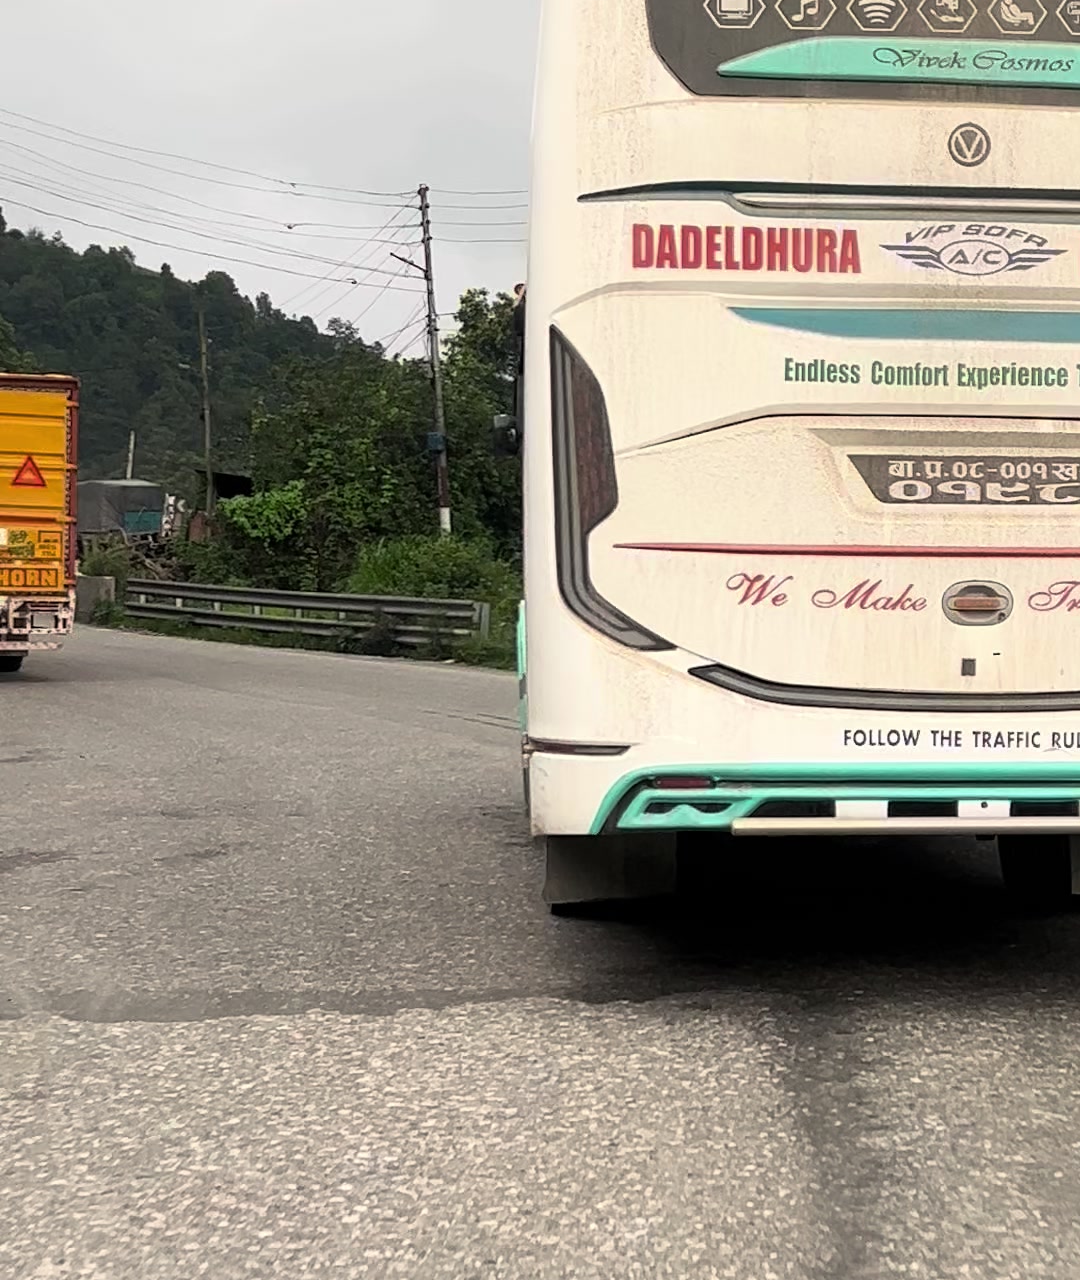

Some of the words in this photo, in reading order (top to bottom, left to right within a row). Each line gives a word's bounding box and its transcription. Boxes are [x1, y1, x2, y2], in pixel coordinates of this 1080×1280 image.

[872, 47, 967, 70] Vivek
[972, 49, 1075, 72] Cosmos
[905, 224, 957, 244] VIP
[962, 223, 1049, 248] SOFA
[632, 223, 862, 274] DADELDHURA
[946, 248, 1003, 265] A/C
[784, 357, 861, 384] Endless
[871, 360, 949, 387] Comfort
[956, 362, 1069, 390] Experience
[726, 572, 794, 607] We
[811, 578, 928, 612] Make
[843, 729, 921, 747] FOLLOW
[930, 730, 963, 748] THE
[972, 730, 1042, 749] TRAFFIC
